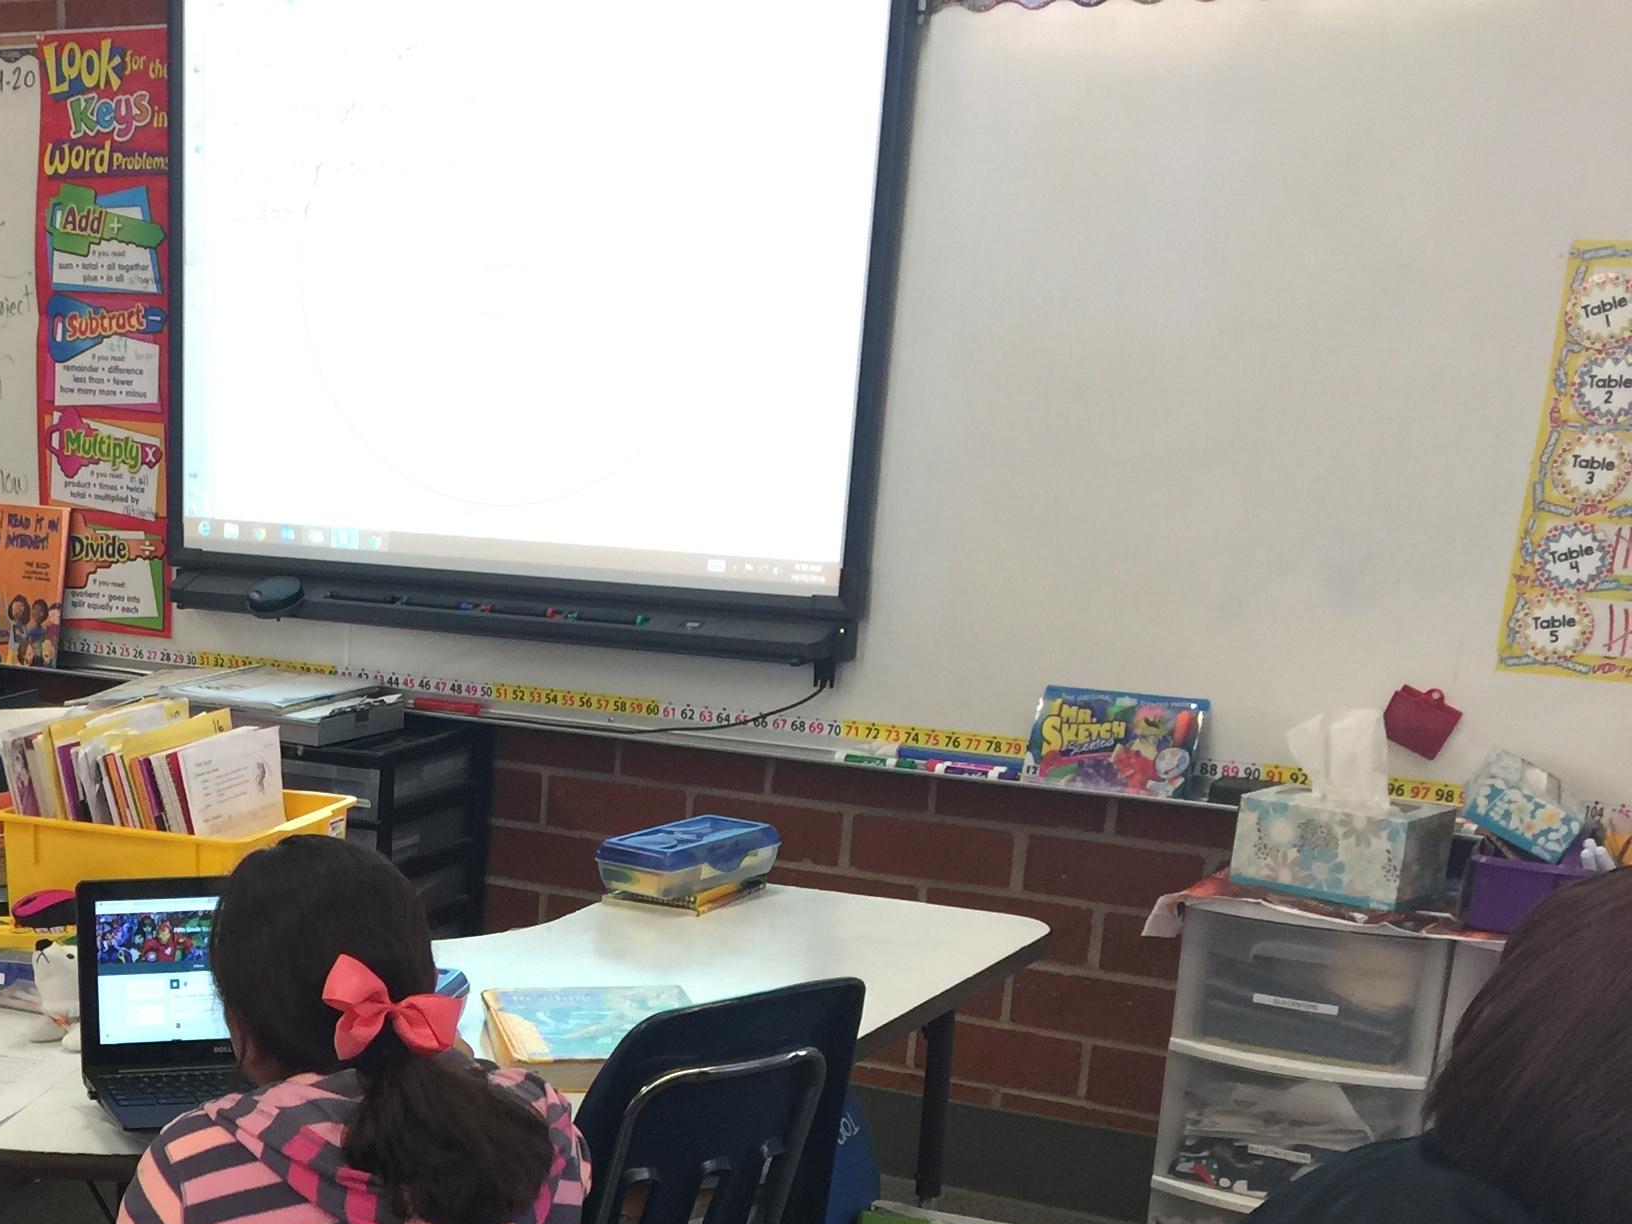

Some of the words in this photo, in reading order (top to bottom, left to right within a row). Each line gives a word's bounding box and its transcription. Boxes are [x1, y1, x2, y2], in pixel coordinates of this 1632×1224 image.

[43, 37, 122, 95] Look
[124, 50, 147, 76] for
[67, 91, 152, 142] Keys
[153, 106, 167, 128] in
[62, 205, 105, 238] Add
[118, 261, 149, 273] together
[1581, 295, 1628, 319] Table
[66, 302, 146, 342] Subtract
[107, 365, 144, 375] difference
[1588, 374, 1632, 390] Table
[1603, 390, 1613, 405] 2
[63, 428, 144, 473] Multiply
[1571, 454, 1616, 472] Table
[1585, 471, 1595, 485] 3
[70, 534, 129, 562] Divide
[1548, 543, 1595, 564] Table
[1569, 561, 1581, 574] 4
[1532, 615, 1577, 630] Table
[1549, 629, 1559, 643] 5
[80, 642, 90, 653] 22
[94, 643, 104, 654] 23
[106, 644, 117, 655] 24
[120, 645, 131, 657] 25
[133, 647, 144, 659] 26
[147, 649, 158, 660] 27
[160, 650, 171, 662] 28
[174, 651, 184, 663] 29
[186, 653, 197, 665] 30
[199, 655, 210, 665] 31
[213, 656, 224, 667] 32
[387, 676, 400, 687] 44
[403, 677, 415, 689] 45
[418, 679, 431, 691] 46
[434, 681, 446, 692] 47
[450, 681, 463, 694] 48
[465, 683, 478, 695] 49
[481, 685, 493, 697] 50
[496, 687, 508, 699] 51
[512, 689, 525, 701] 52
[529, 690, 541, 703] 53
[545, 692, 558, 705] 54
[562, 694, 574, 706] 55
[579, 695, 592, 709] 56
[596, 698, 609, 710] 57
[613, 699, 627, 712] 58
[630, 700, 643, 714] 59
[646, 703, 659, 716] 60
[663, 705, 676, 718] 61
[681, 707, 694, 720] 62
[699, 709, 713, 723] 63
[716, 711, 731, 725] 64
[772, 717, 787, 730] 67
[791, 719, 805, 732] 68
[809, 721, 824, 734] 69
[827, 723, 841, 736] 70
[845, 724, 859, 737] 71
[865, 726, 880, 739] 72
[885, 728, 900, 741] 73
[904, 729, 919, 743] 74
[924, 732, 939, 745] 75
[945, 734, 960, 748] 76
[966, 737, 981, 751] 77
[986, 739, 1002, 753] 78
[1005, 741, 1021, 755] 79
[1200, 762, 1218, 777] 88
[1221, 764, 1240, 779] 89
[1244, 766, 1261, 781] 90
[1265, 768, 1283, 782] 91
[1289, 771, 1308, 785] 92
[1387, 781, 1405, 797] 96
[1410, 783, 1430, 799] 97
[1435, 787, 1454, 803] 98
[1585, 803, 1604, 820] 104
